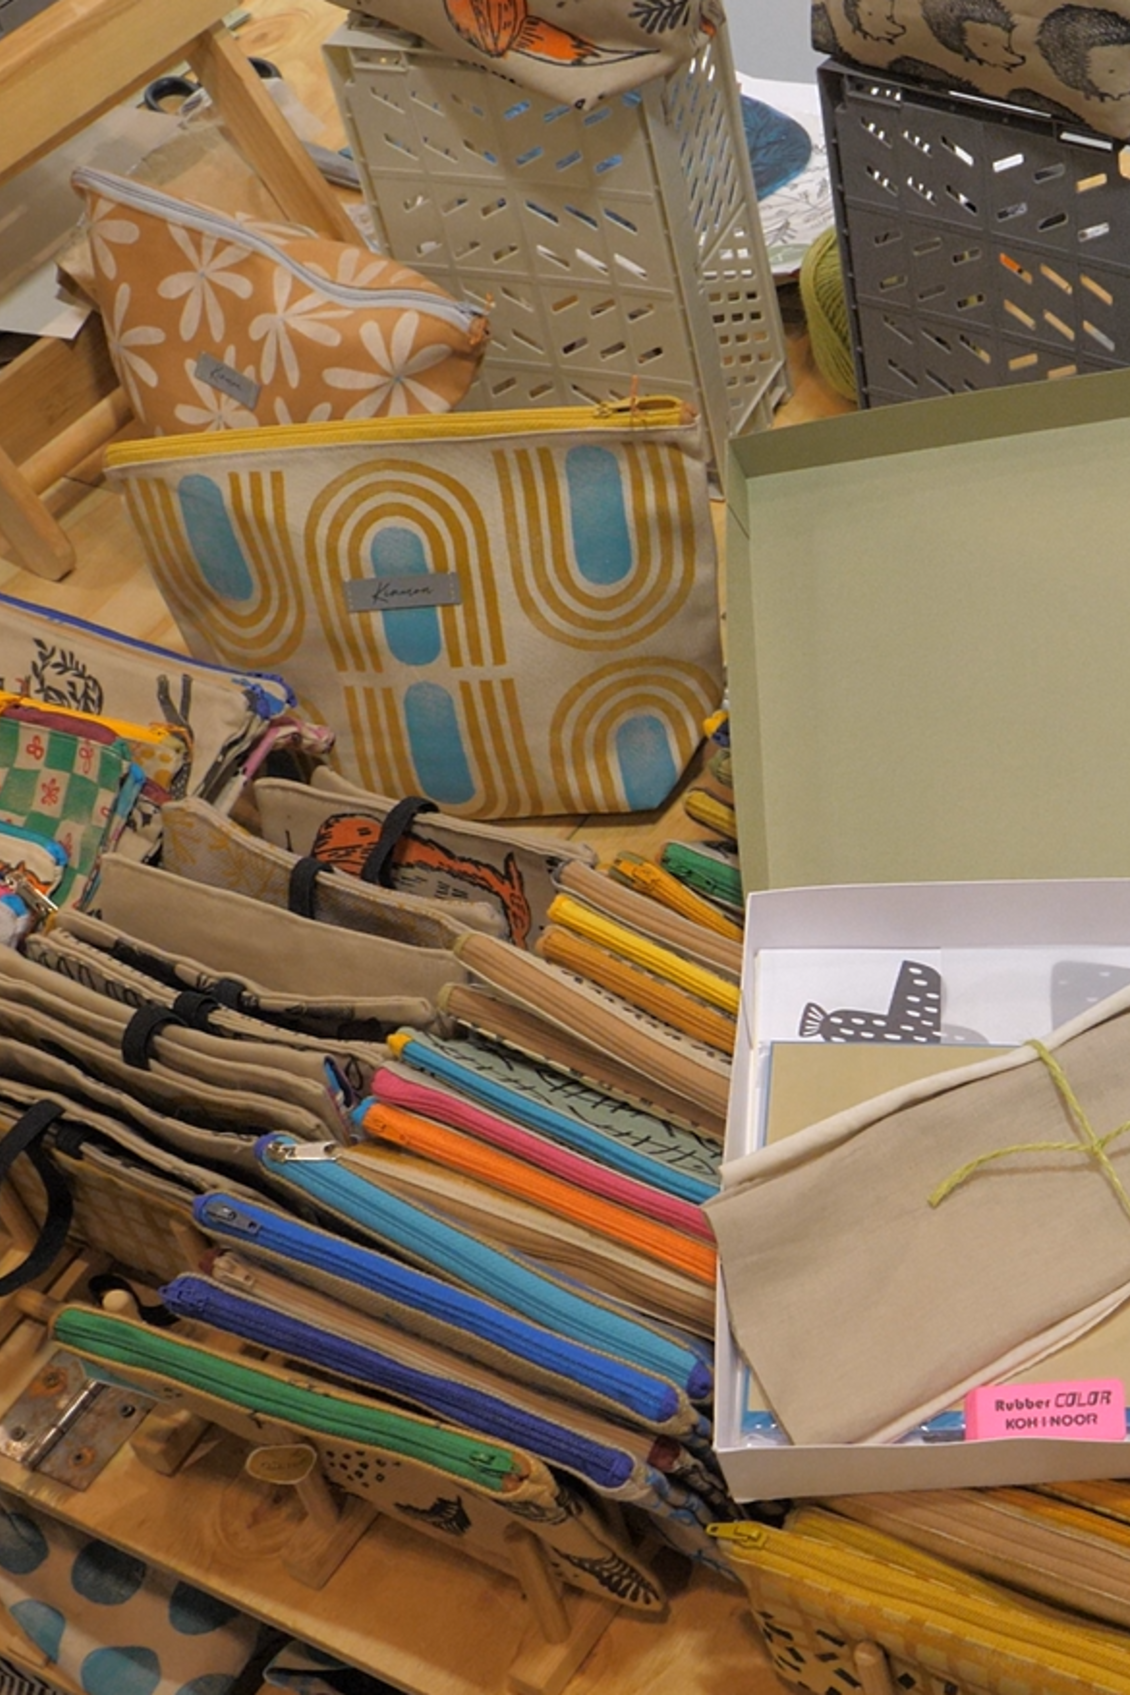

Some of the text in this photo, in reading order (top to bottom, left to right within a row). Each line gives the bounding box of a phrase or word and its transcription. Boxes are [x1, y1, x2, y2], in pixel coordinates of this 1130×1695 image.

[994, 1390, 1112, 1412] Rubber COLOR
[1005, 1412, 1098, 1430] KOH I NOOR
